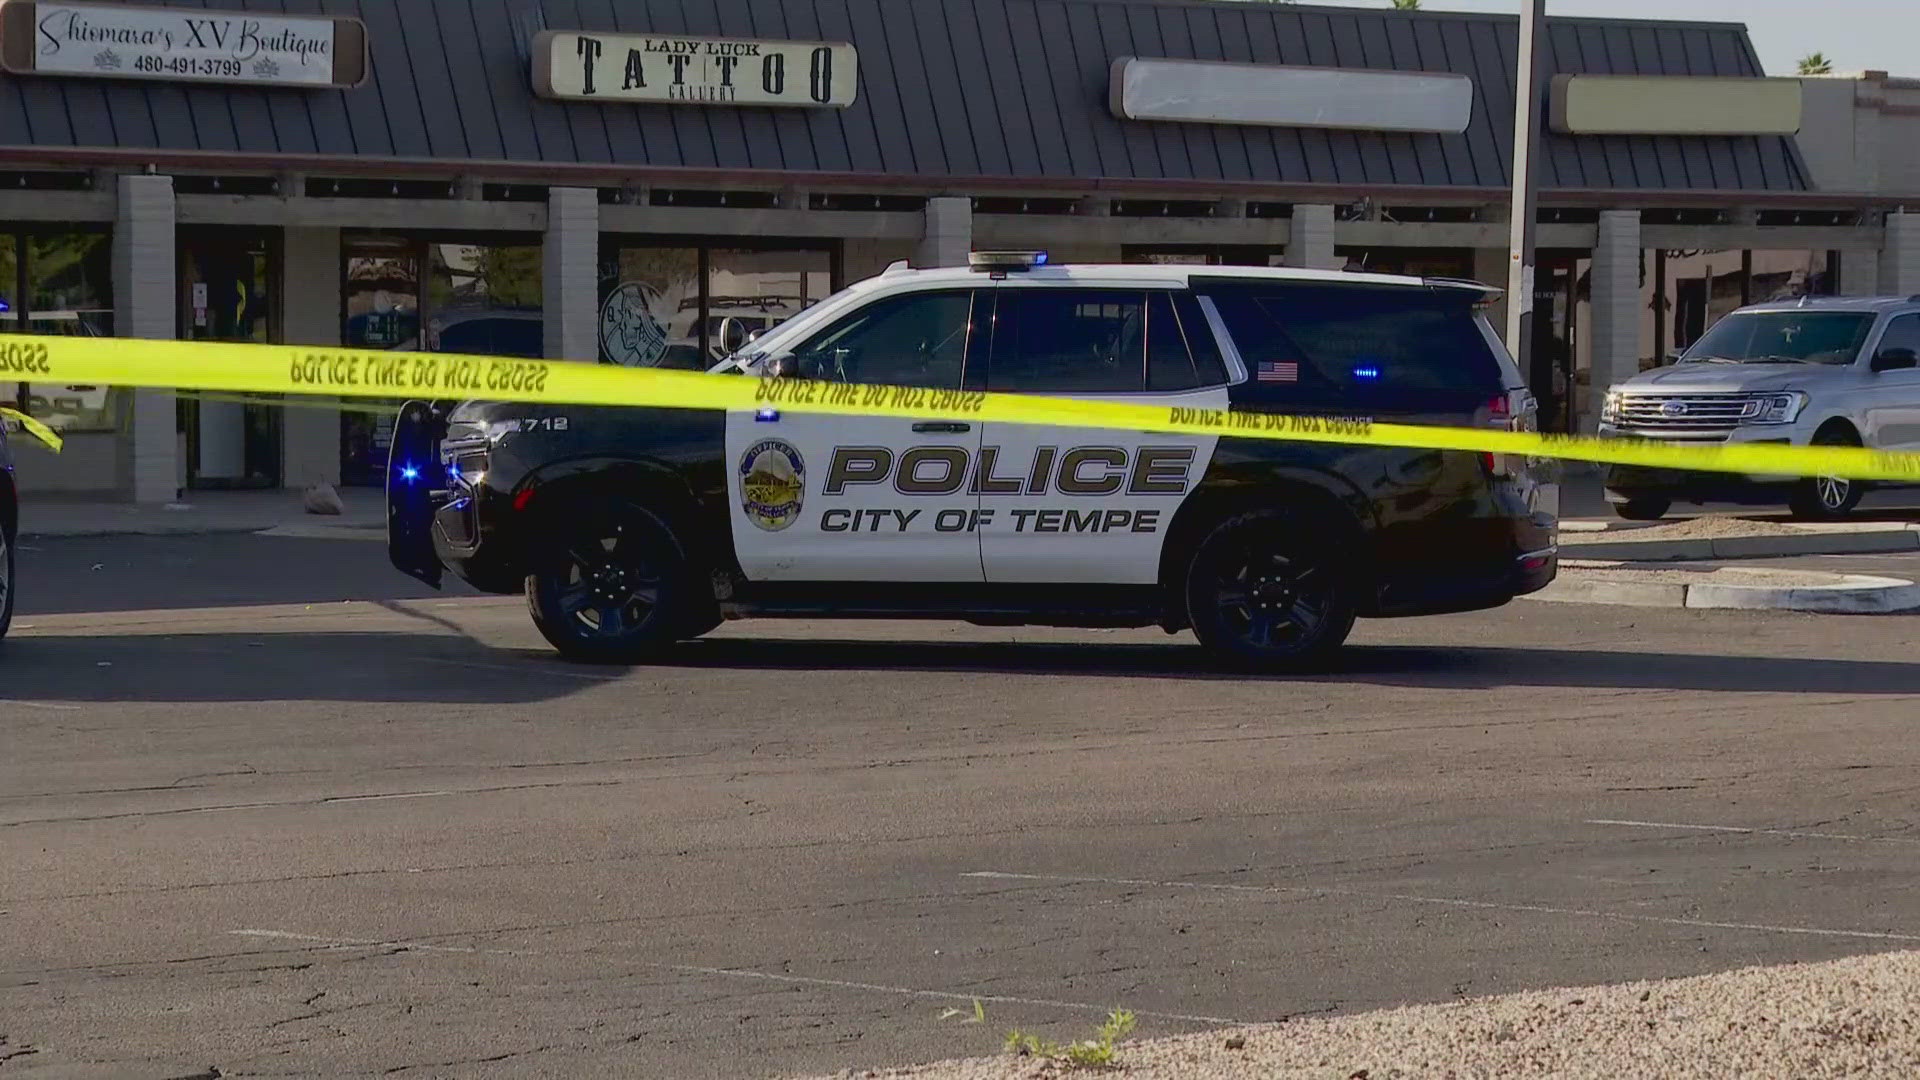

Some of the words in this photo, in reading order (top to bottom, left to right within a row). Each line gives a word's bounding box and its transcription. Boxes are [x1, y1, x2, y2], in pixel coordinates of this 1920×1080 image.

[39, 9, 172, 55] Shiomara's
[184, 19, 230, 49] XV
[231, 20, 329, 66] Boutique
[645, 39, 699, 54] LADY
[707, 42, 760, 57] LUCK
[134, 55, 241, 76] 480-491-3799
[577, 36, 832, 104] TATTOO
[668, 84, 736, 102] GALLERY
[822, 445, 1198, 497] POLICE
[820, 508, 922, 533] CITY
[934, 508, 995, 533] OF
[1010, 508, 1161, 533] TEMPE
